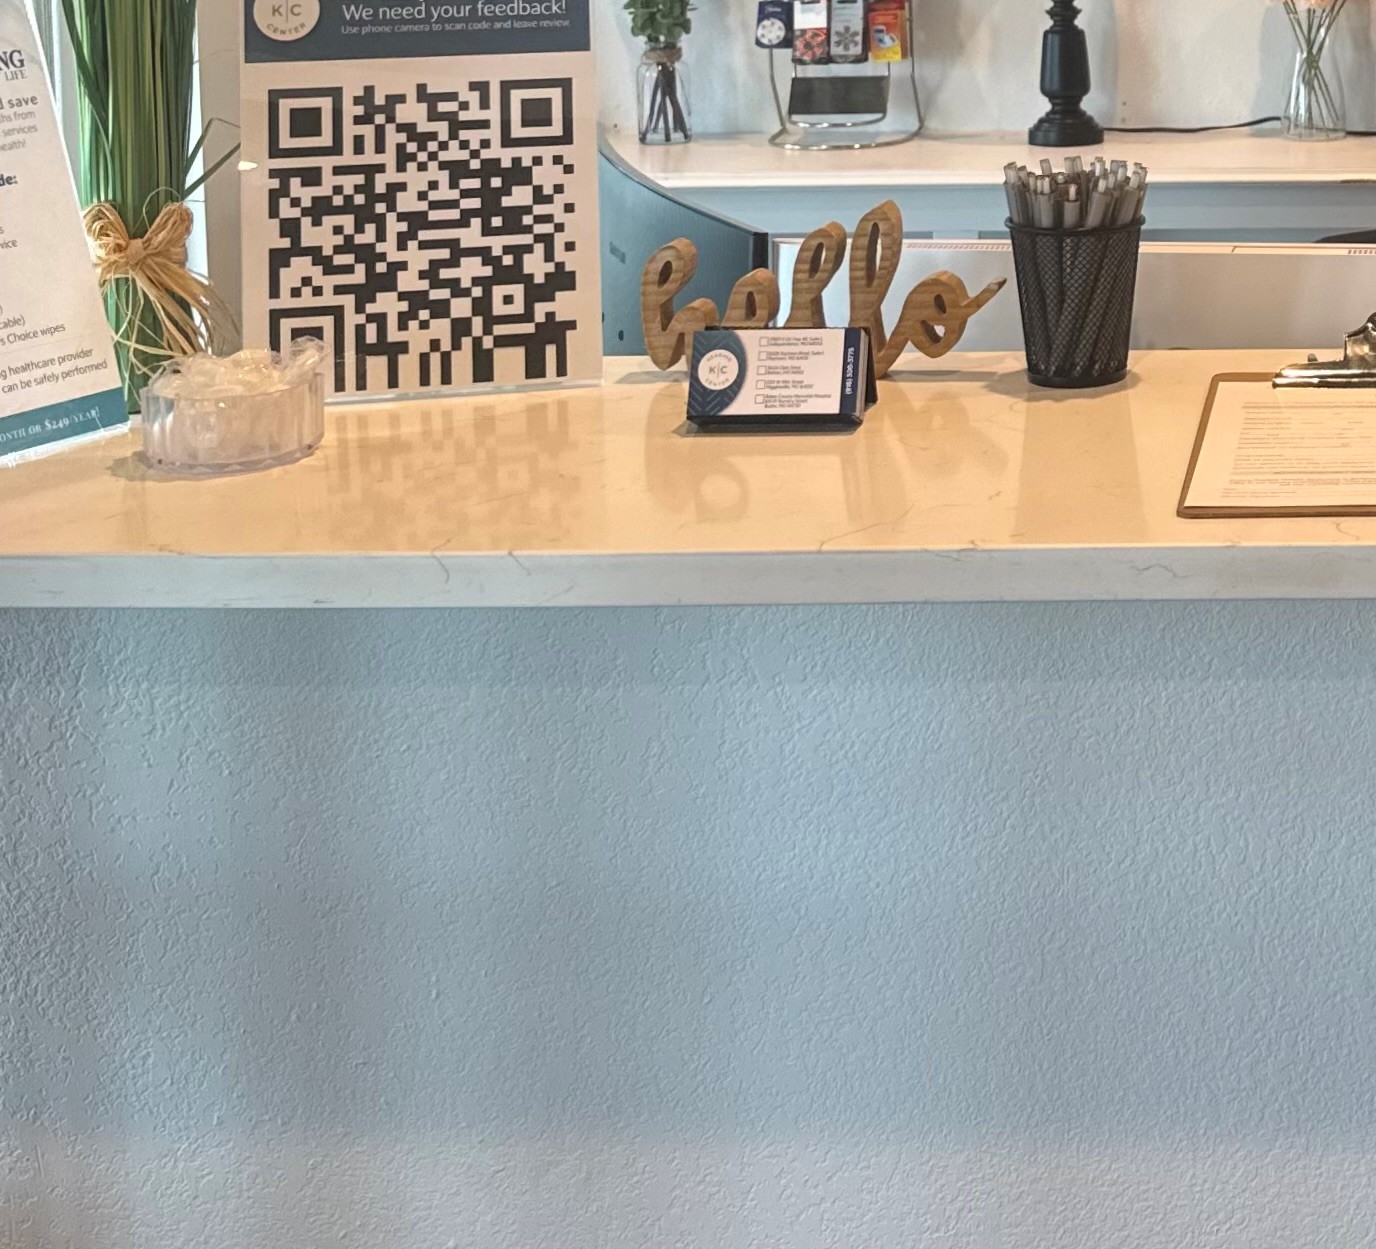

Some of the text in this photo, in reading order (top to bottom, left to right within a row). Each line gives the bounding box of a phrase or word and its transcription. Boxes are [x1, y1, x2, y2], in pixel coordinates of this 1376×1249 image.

[342, 4, 374, 21] We
[379, 2, 426, 20] need
[430, 4, 473, 22] your
[341, 25, 360, 34] Use
[362, 24, 392, 35] phone
[394, 24, 430, 32] camera
[431, 23, 442, 31] to
[444, 22, 466, 31] scan
[468, 20, 492, 30] code
[493, 20, 512, 29] and
[513, 20, 538, 28] leave
[5, 69, 27, 82] LIFE
[7, 95, 39, 109] save
[14, 110, 36, 123] from
[4, 124, 38, 137] services
[7, 329, 39, 344] Choice
[40, 323, 66, 337] wipes
[8, 358, 56, 376] healthcare
[57, 348, 94, 366] provider
[2, 358, 108, 393] can be safely performed
[28, 423, 43, 435] OR
